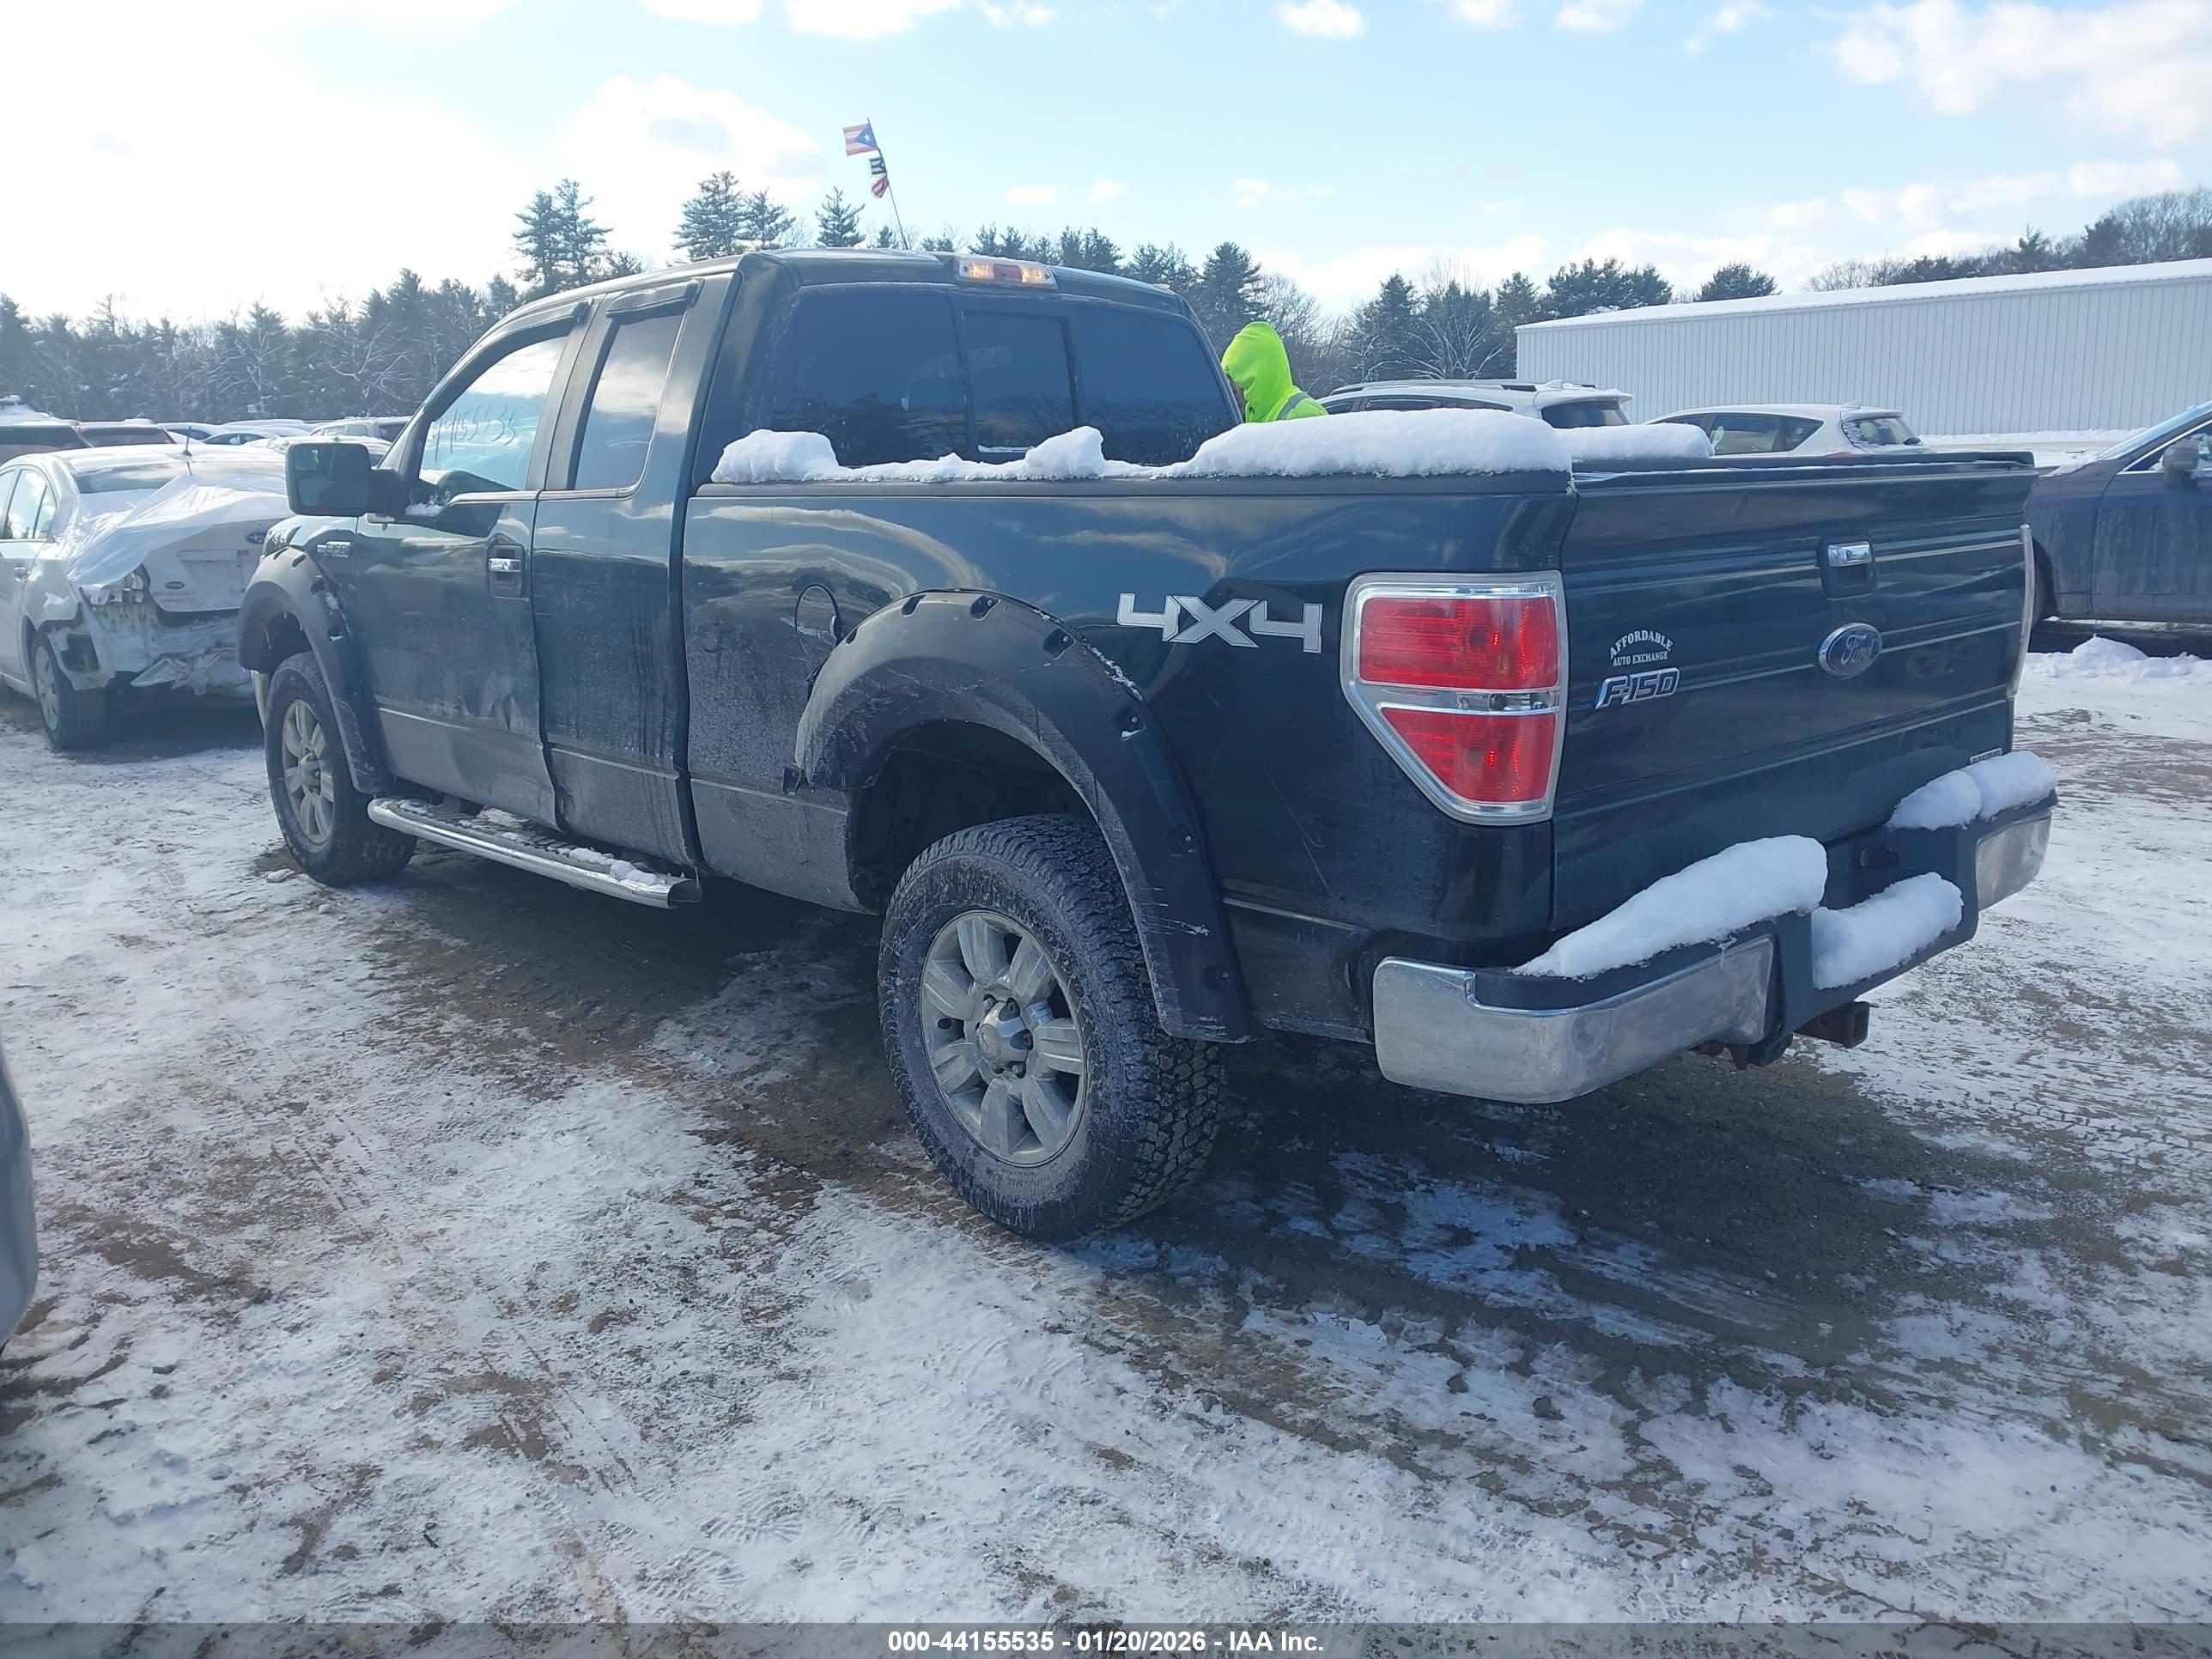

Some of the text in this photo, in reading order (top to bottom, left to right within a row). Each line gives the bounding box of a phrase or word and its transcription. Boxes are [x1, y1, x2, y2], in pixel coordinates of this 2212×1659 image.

[1610, 629, 1674, 660] AFFORDABLE
[1613, 651, 1668, 667] AUTO EXCHANGE
[1840, 634, 1875, 665] Ford
